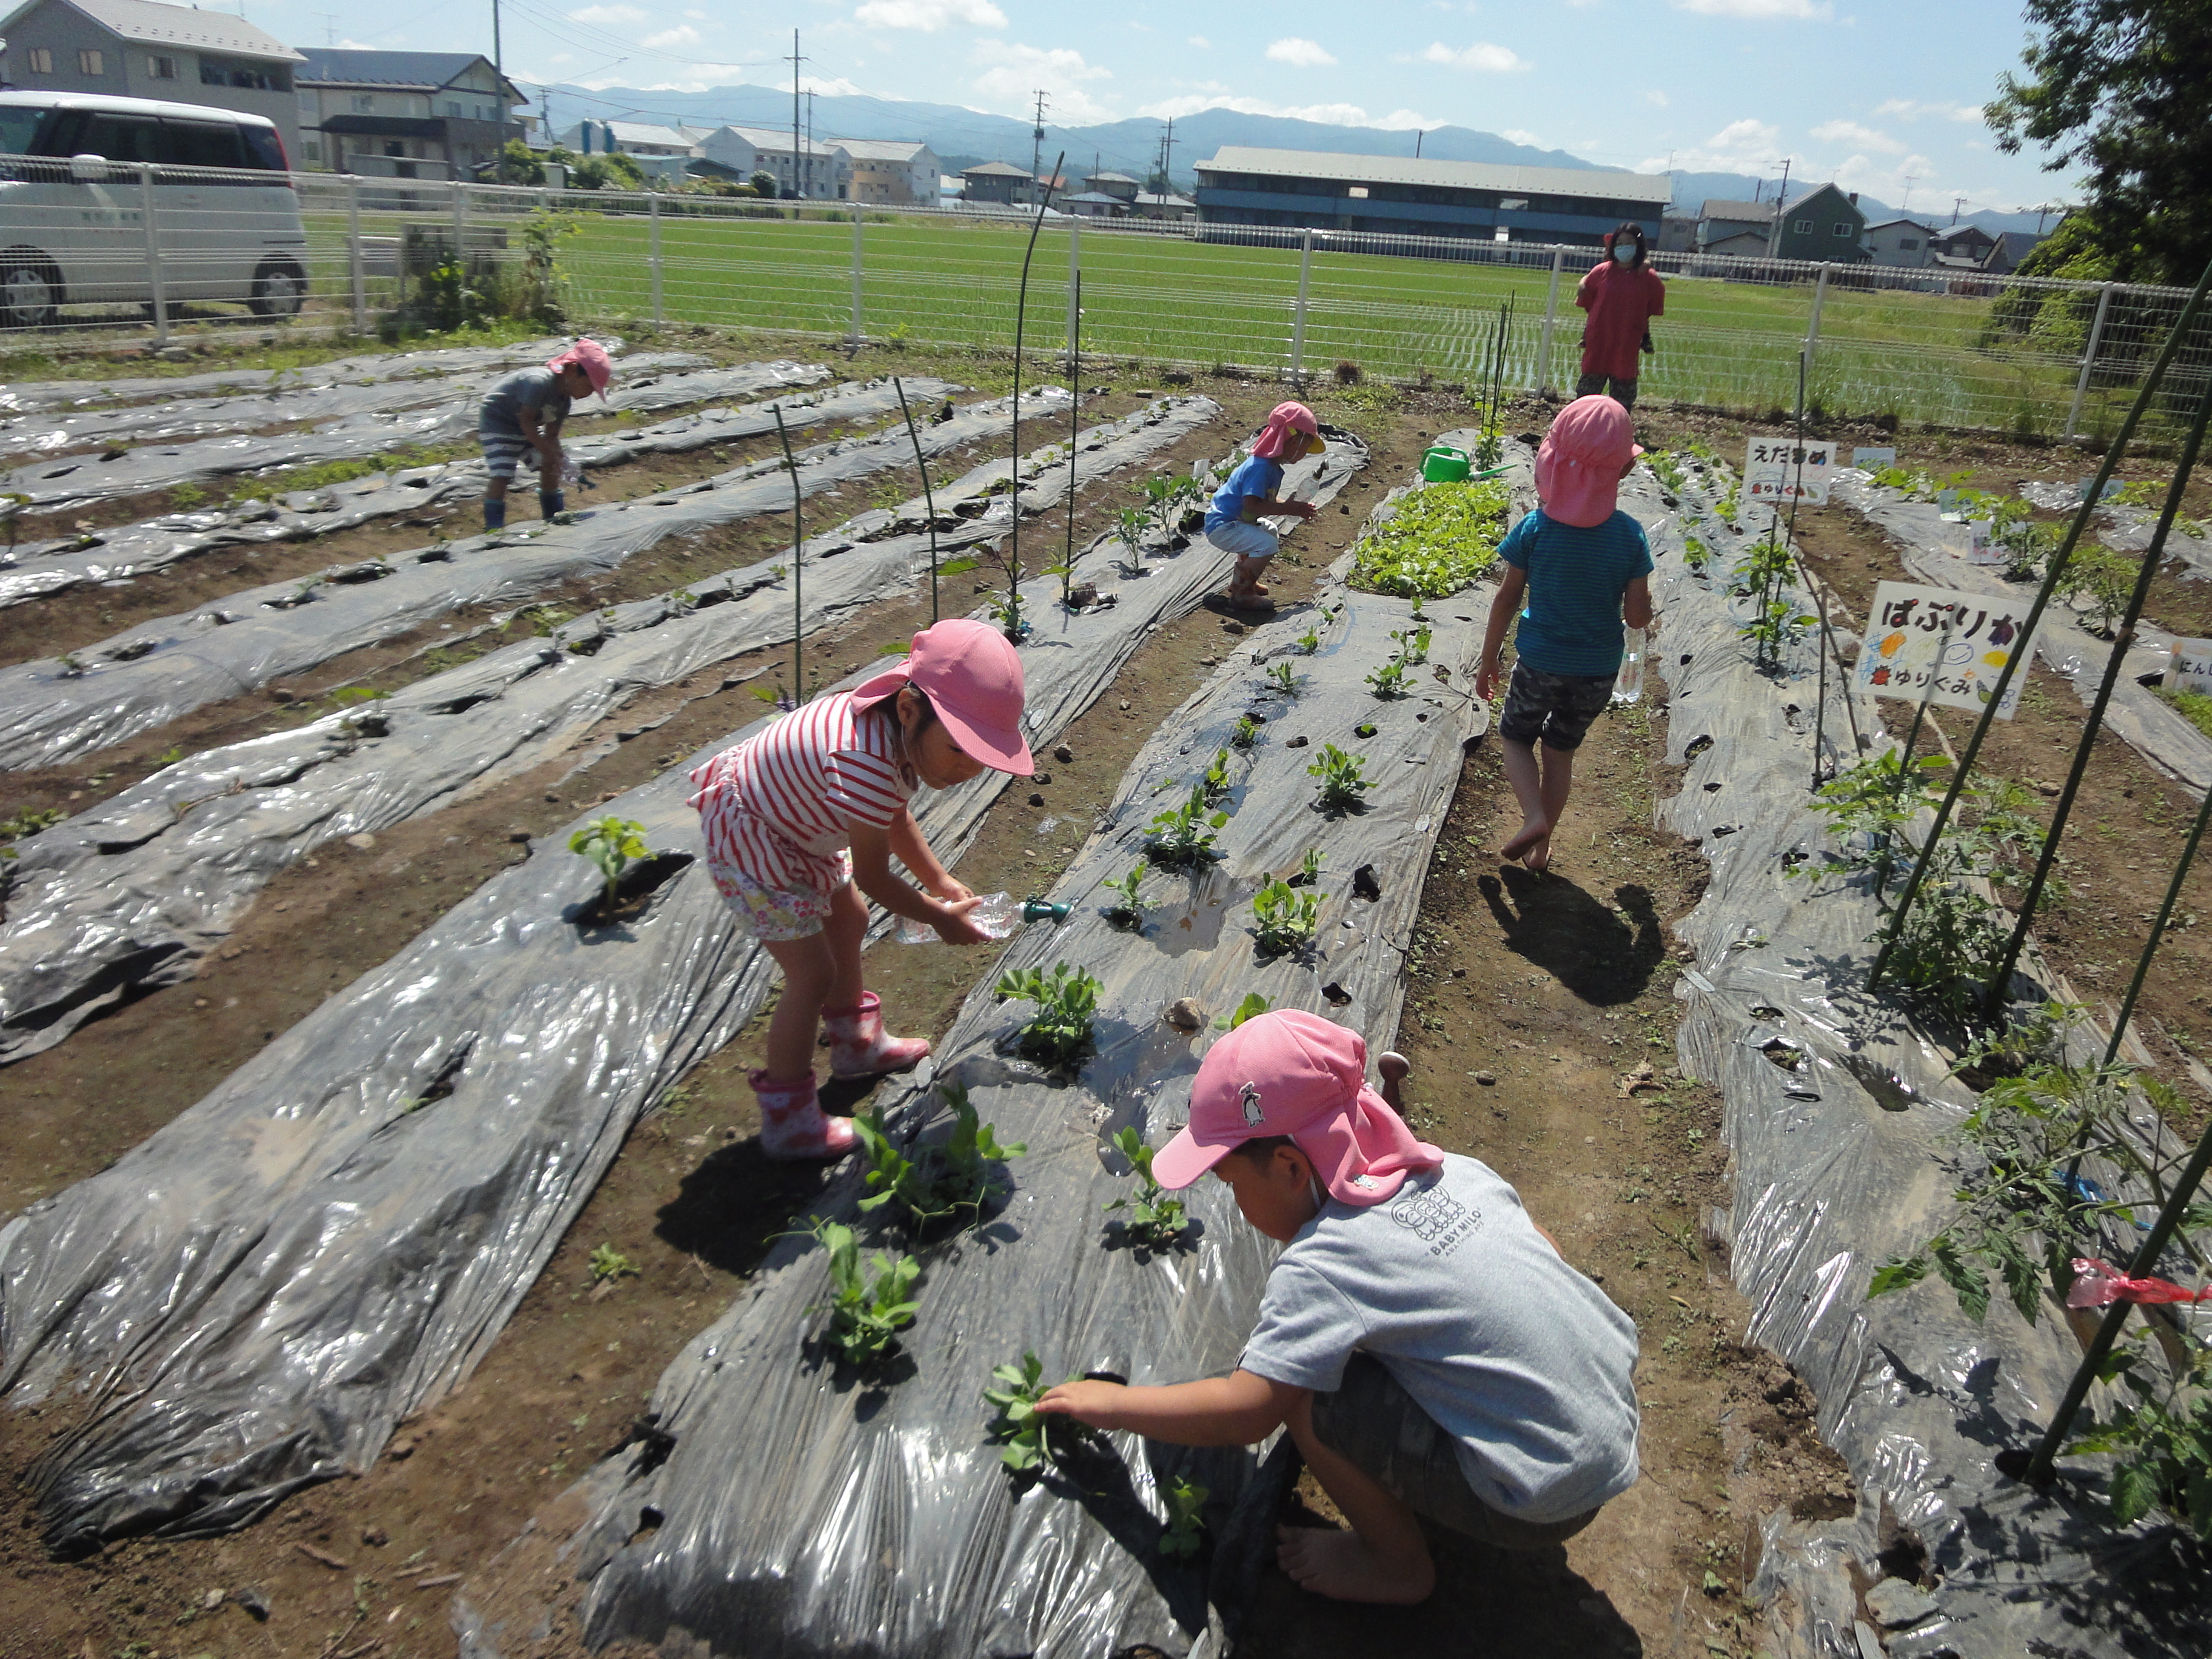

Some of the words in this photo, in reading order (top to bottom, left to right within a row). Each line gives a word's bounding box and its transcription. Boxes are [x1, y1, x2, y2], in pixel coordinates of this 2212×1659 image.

[1882, 598, 2024, 646] ぱぷりか
[1895, 669, 1972, 695] ゆりぐみ
